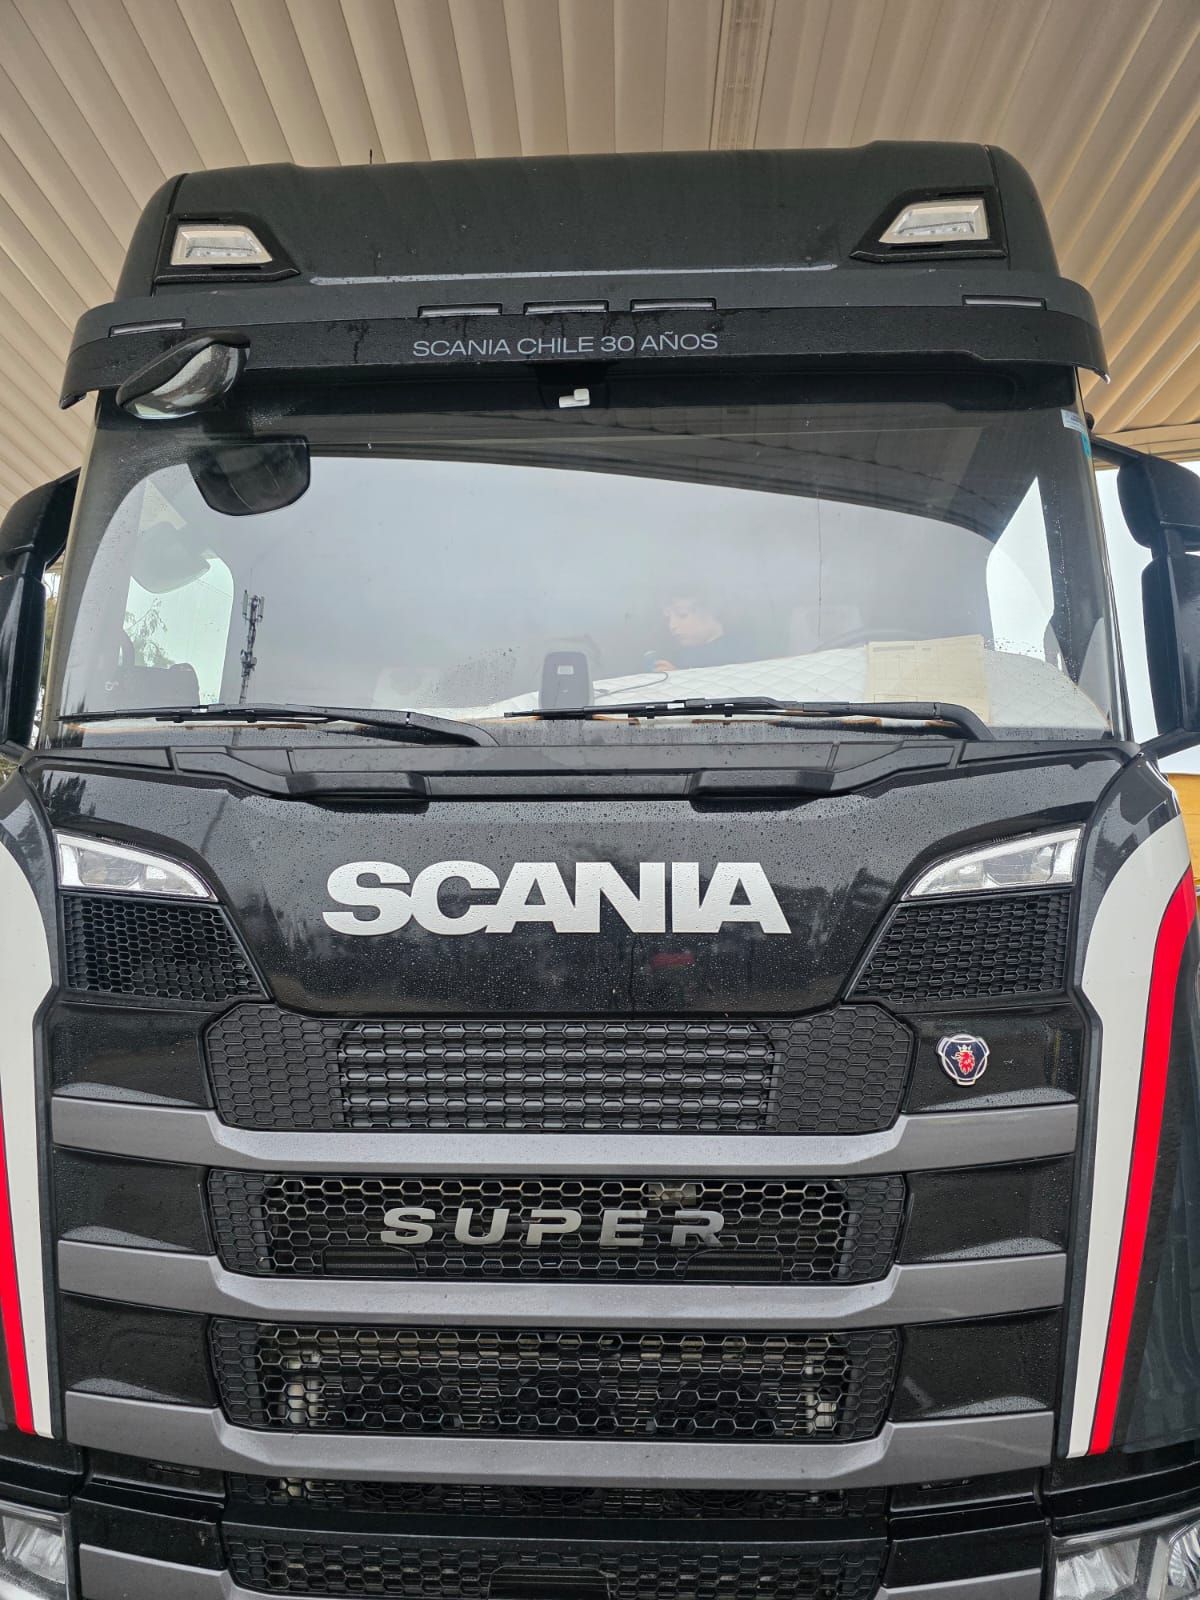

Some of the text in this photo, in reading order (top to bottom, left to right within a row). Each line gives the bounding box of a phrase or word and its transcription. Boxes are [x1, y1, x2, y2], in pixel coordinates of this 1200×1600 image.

[412, 330, 719, 357] SCANIA CHILE 30 AÑOS
[322, 860, 792, 936] SCANIA
[379, 1207, 725, 1248] SUPER
